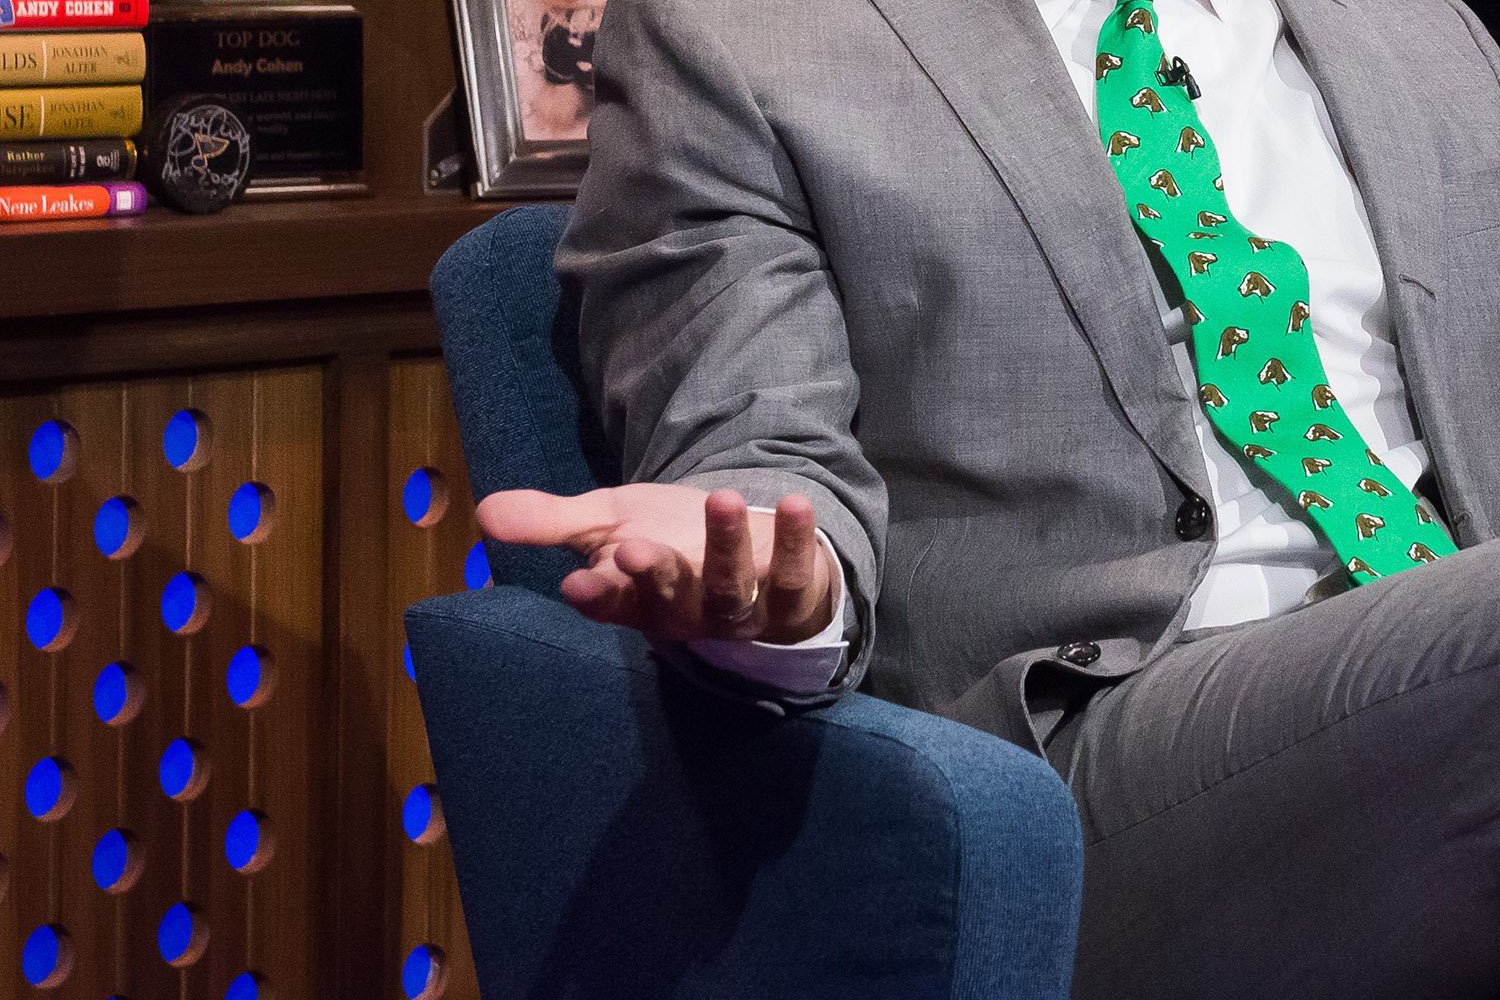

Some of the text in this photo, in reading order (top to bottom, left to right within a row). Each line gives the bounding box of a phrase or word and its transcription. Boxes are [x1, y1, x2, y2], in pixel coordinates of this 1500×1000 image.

[16, 0, 114, 17] ANDY COHEN
[214, 30, 253, 48] TOP
[212, 57, 304, 77] Andy Cohen
[6, 150, 46, 162] Rather
[41, 193, 96, 215] Leakes
